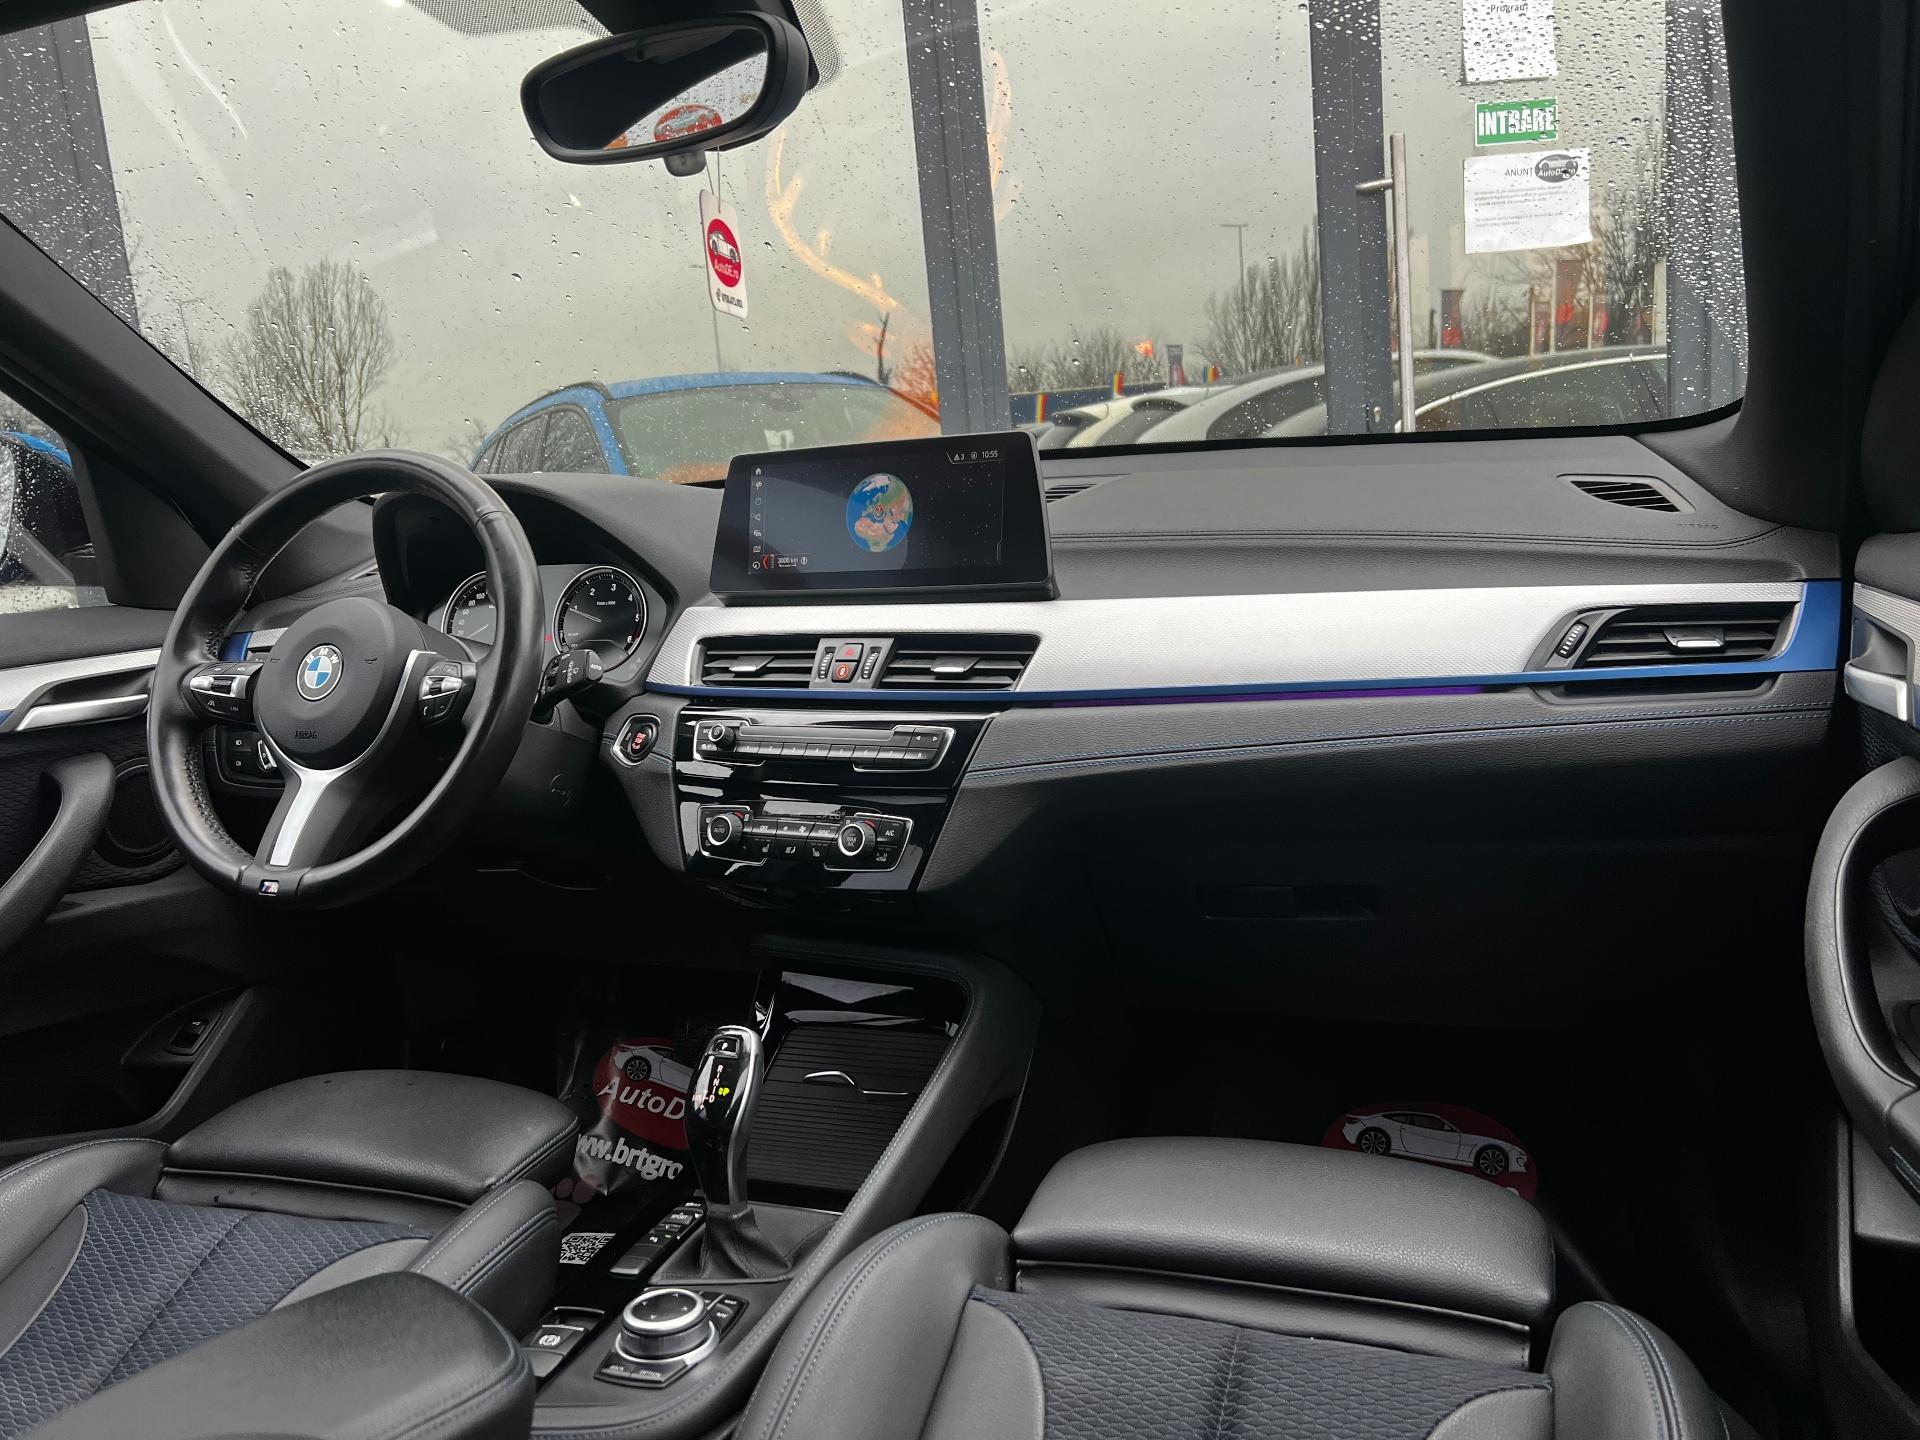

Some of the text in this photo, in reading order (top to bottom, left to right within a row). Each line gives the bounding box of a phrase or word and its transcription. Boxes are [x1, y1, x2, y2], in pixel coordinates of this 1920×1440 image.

[1478, 106, 1555, 136] INTRARE
[982, 450, 998, 458] 10:55
[610, 583, 617, 591] 3
[589, 588, 595, 596] 2
[627, 594, 633, 602] 4
[635, 613, 640, 622] 5
[626, 635, 633, 644] 6
[305, 647, 340, 664] BMW
[717, 1064, 724, 1073] R
[713, 1078, 720, 1087] N
[597, 1077, 686, 1119] AutoD
[708, 1094, 715, 1103] D
